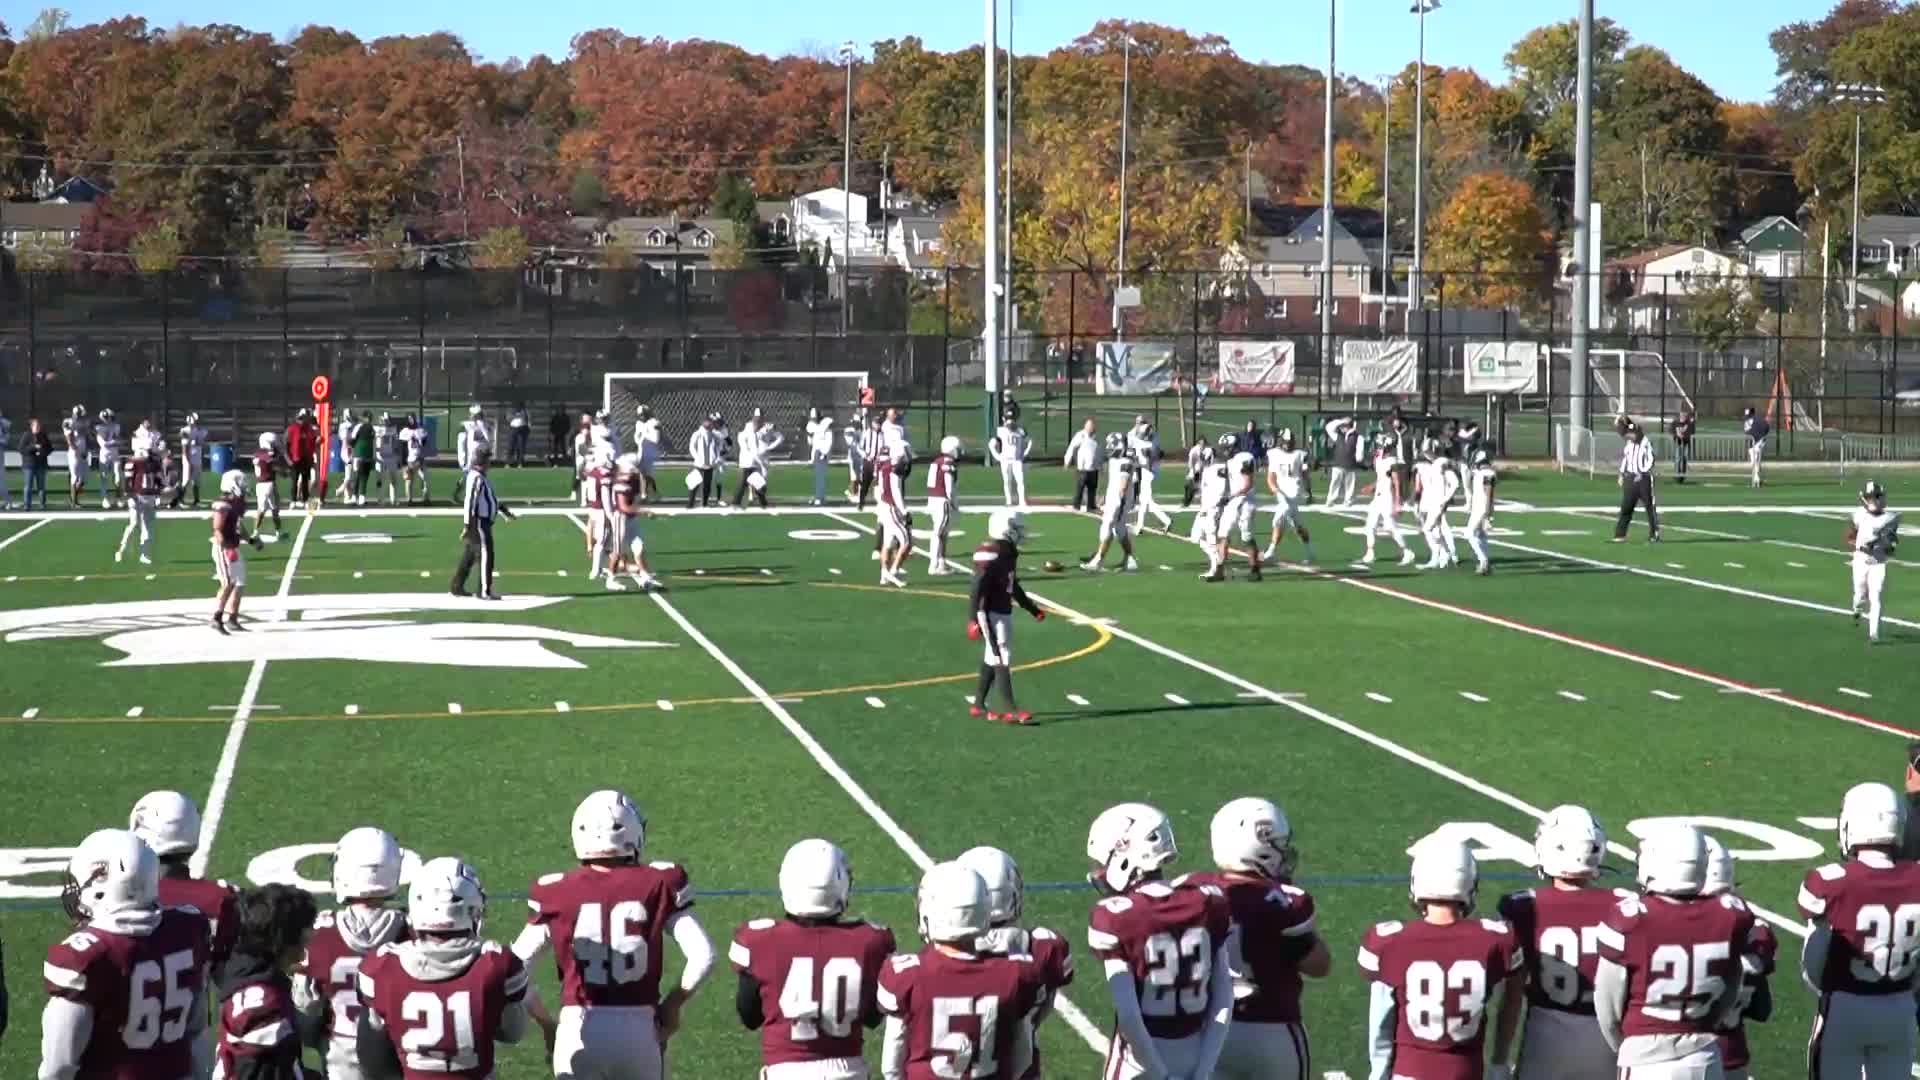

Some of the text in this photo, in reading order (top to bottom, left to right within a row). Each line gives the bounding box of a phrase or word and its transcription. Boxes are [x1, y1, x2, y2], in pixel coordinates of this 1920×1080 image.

[573, 901, 649, 985] 46
[1142, 927, 1212, 1016] 23
[1641, 941, 1730, 1021] 25
[1850, 904, 1920, 982] 38
[119, 949, 194, 1050] 65
[231, 985, 265, 1017] 12
[401, 991, 480, 1072] 21
[778, 956, 863, 1042] 40
[929, 995, 1000, 1080] 51
[1405, 960, 1487, 1042] 83
